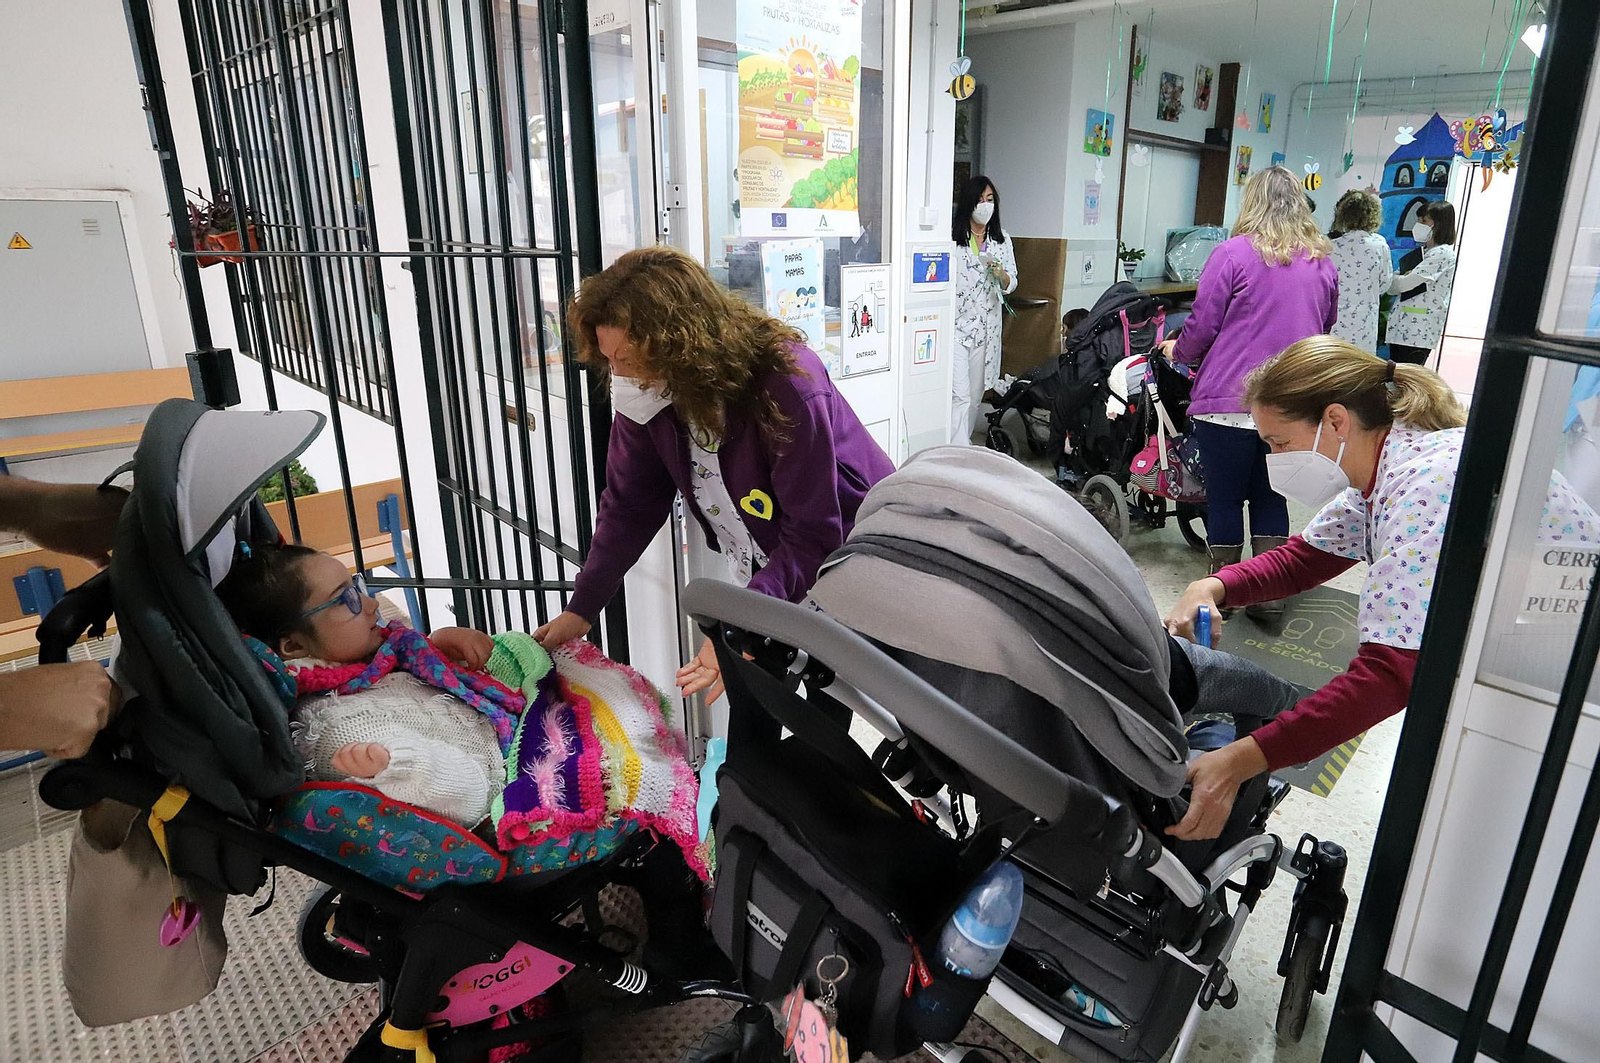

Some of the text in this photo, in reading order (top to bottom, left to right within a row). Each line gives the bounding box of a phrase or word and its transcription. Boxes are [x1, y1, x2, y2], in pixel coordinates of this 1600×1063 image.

[762, 6, 790, 22] FRUTAS
[798, 15, 840, 35] HORTALIZAS
[855, 350, 877, 359] ENTRADA
[1525, 596, 1588, 614] PUER
[1244, 639, 1345, 673] DE SECADO
[1274, 640, 1322, 659] ZONA
